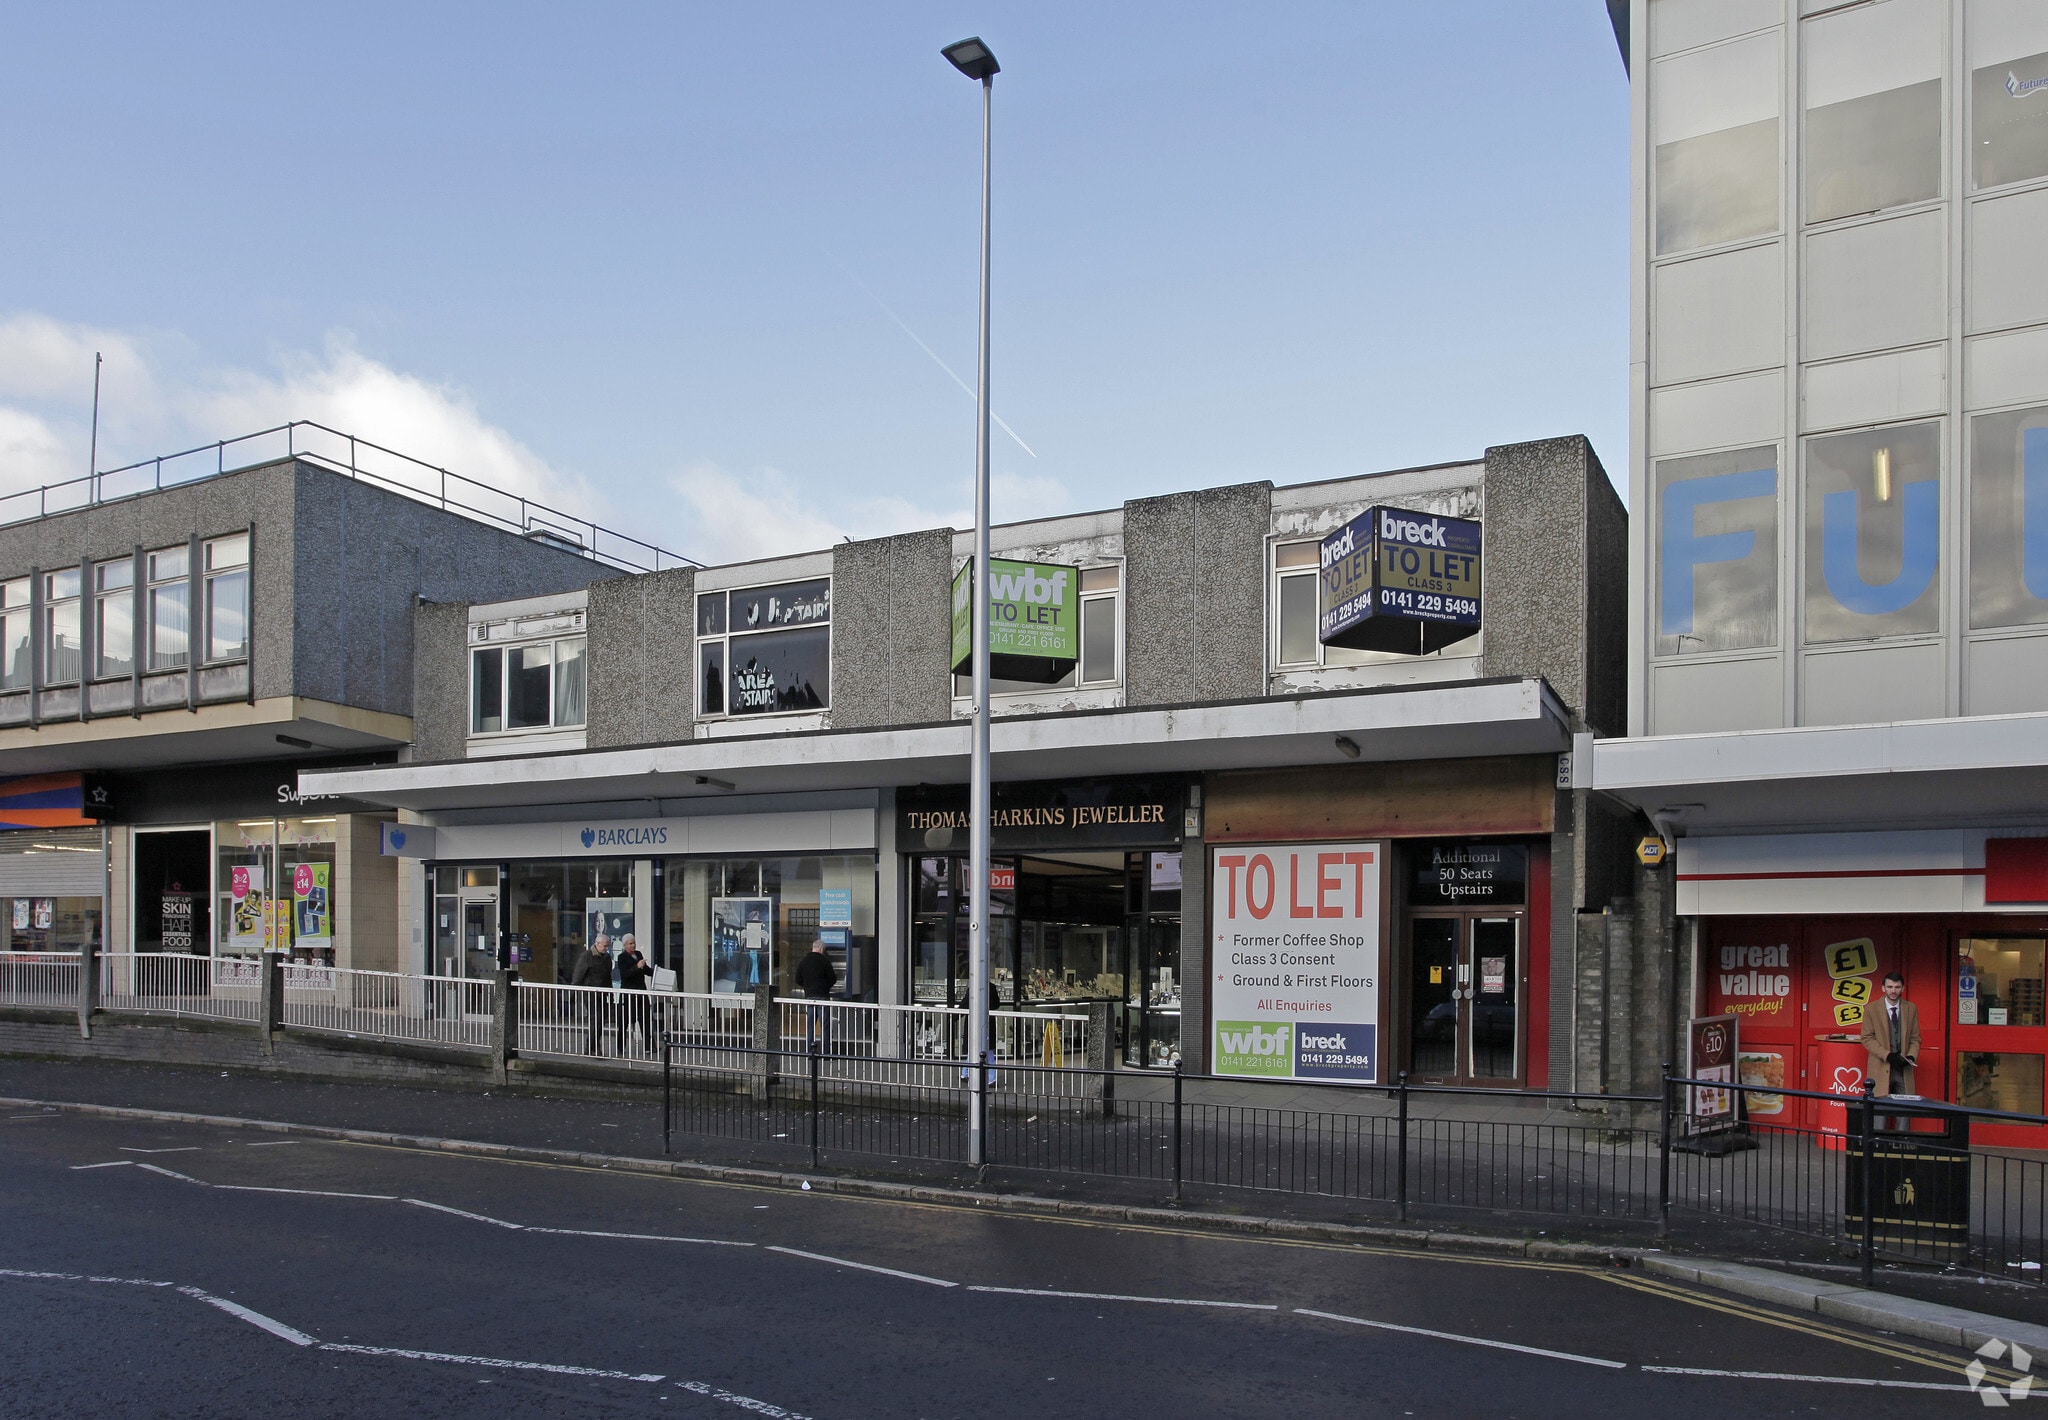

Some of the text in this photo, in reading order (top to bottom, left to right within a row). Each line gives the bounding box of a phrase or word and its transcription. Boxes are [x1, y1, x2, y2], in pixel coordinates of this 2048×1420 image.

[1381, 510, 1446, 547] breck
[1321, 526, 1355, 570] breck
[1322, 547, 1370, 597] TO LET
[1384, 545, 1475, 582] TO LET
[990, 567, 1067, 605] wbf
[1407, 577, 1452, 592] CLASS 3
[1321, 591, 1371, 630] 0141 229 5494
[1381, 590, 1477, 615] 0141 229 5494
[992, 602, 1061, 625] TO LET
[1402, 609, 1457, 620] www.breckproperty.com
[990, 632, 1066, 649] 0141 221 6161
[907, 811, 970, 829] THOMA
[1071, 804, 1165, 829] JEWELLER
[598, 827, 667, 846] BARCLAYS
[1432, 849, 1501, 864] Additional
[1644, 846, 1659, 854] ADT
[1439, 867, 1493, 880] 50 Seats
[296, 878, 309, 889] £14
[1219, 852, 1374, 920] TO LET
[1439, 882, 1493, 899] Upstairs
[162, 903, 191, 914] SKIN
[162, 919, 191, 931] HAIR
[162, 937, 191, 946] FOOD
[1233, 934, 1364, 949] Former Coffee Shop
[1231, 953, 1335, 965] Class 3 Consent
[1720, 943, 1789, 970] great
[1834, 944, 1868, 973] £1
[1233, 974, 1373, 988] Ground & First Floors
[1719, 970, 1790, 996] value
[1836, 980, 1866, 1000] £2
[1257, 999, 1332, 1013] All Enquiries
[1725, 998, 1784, 1016] everyday!
[1839, 1006, 1862, 1022] £3
[1219, 1025, 1289, 1056] wbf
[1301, 1032, 1347, 1050] breck
[1706, 1036, 1722, 1053] £10
[1221, 1056, 1288, 1068] 0141 221 6161
[1301, 1054, 1369, 1065] 0141 229 5494
